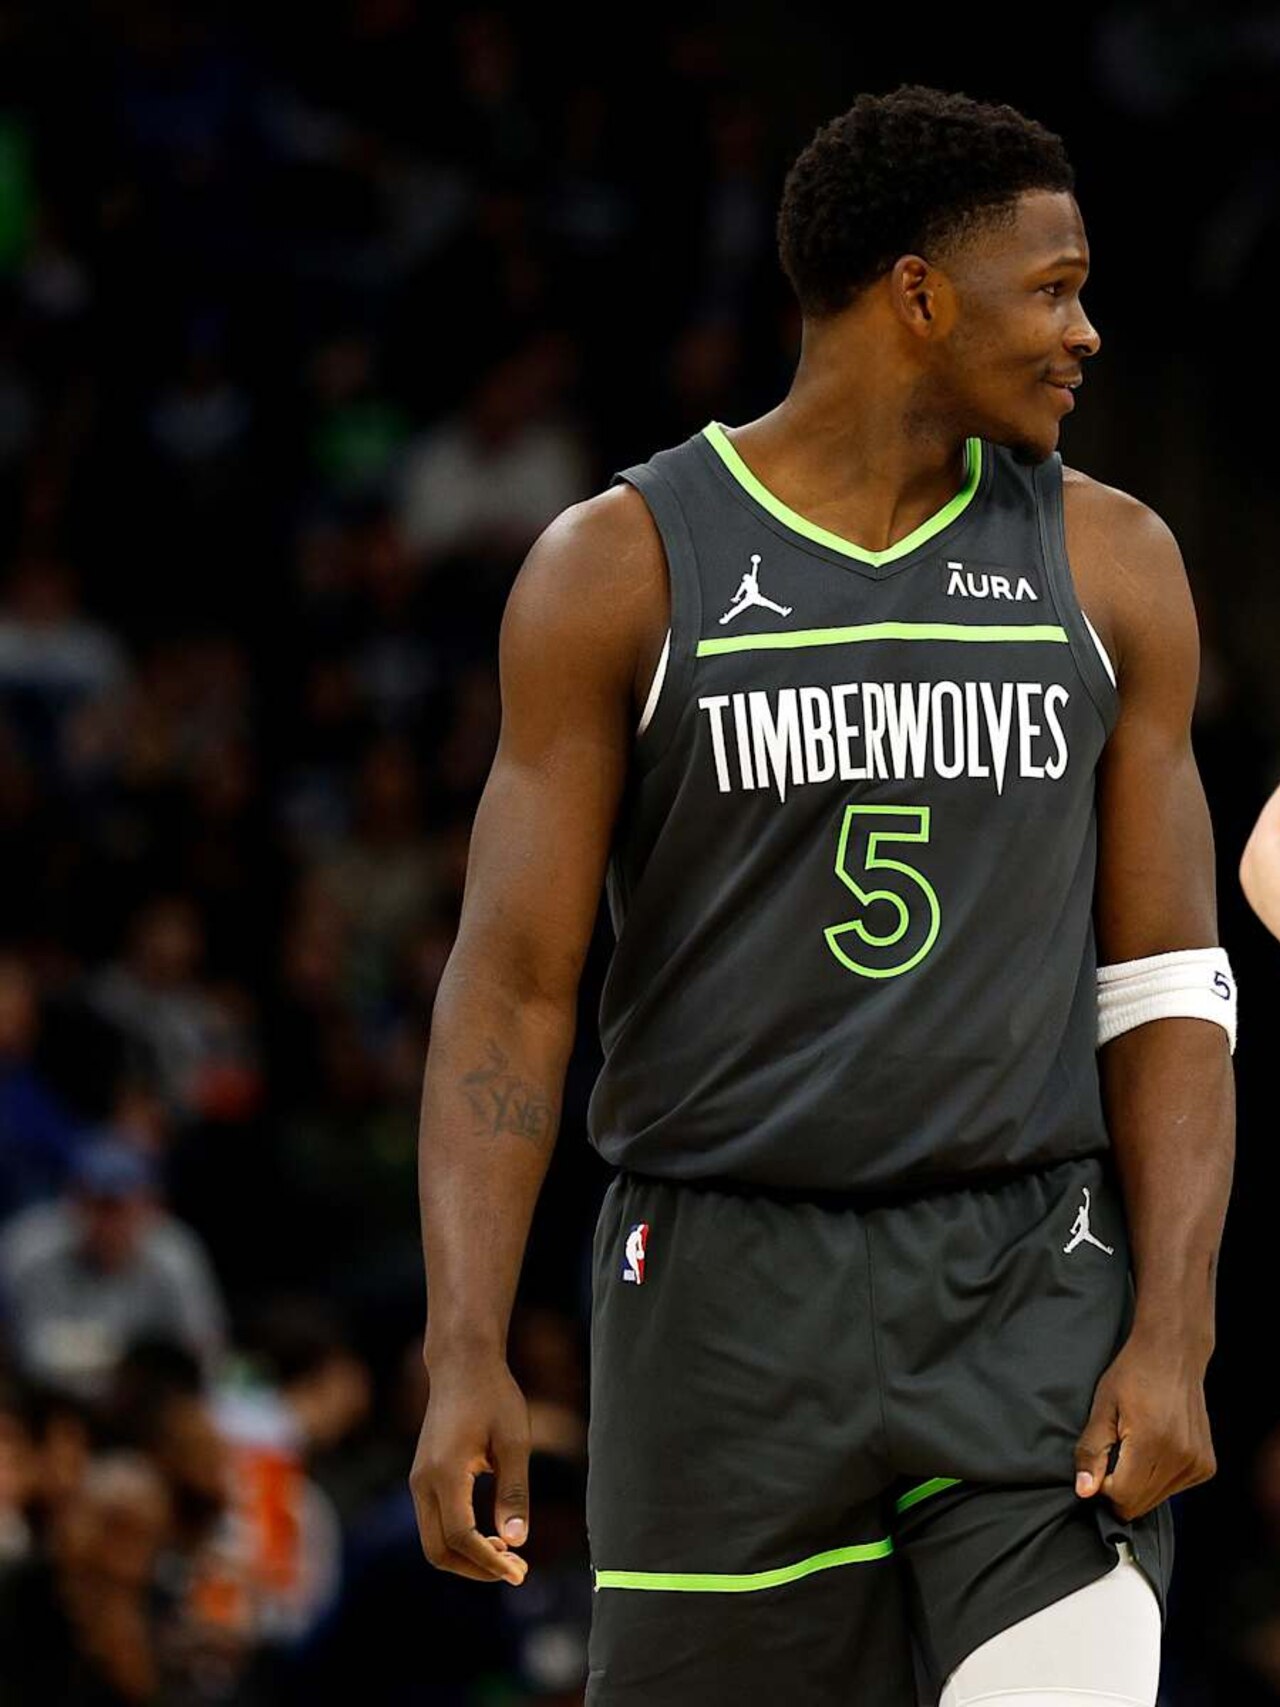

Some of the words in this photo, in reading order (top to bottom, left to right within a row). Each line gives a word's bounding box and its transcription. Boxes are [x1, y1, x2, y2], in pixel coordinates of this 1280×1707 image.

[698, 680, 1071, 804] TIMBERWOLVES
[823, 804, 941, 979] 5
[1210, 970, 1231, 1001] 5
